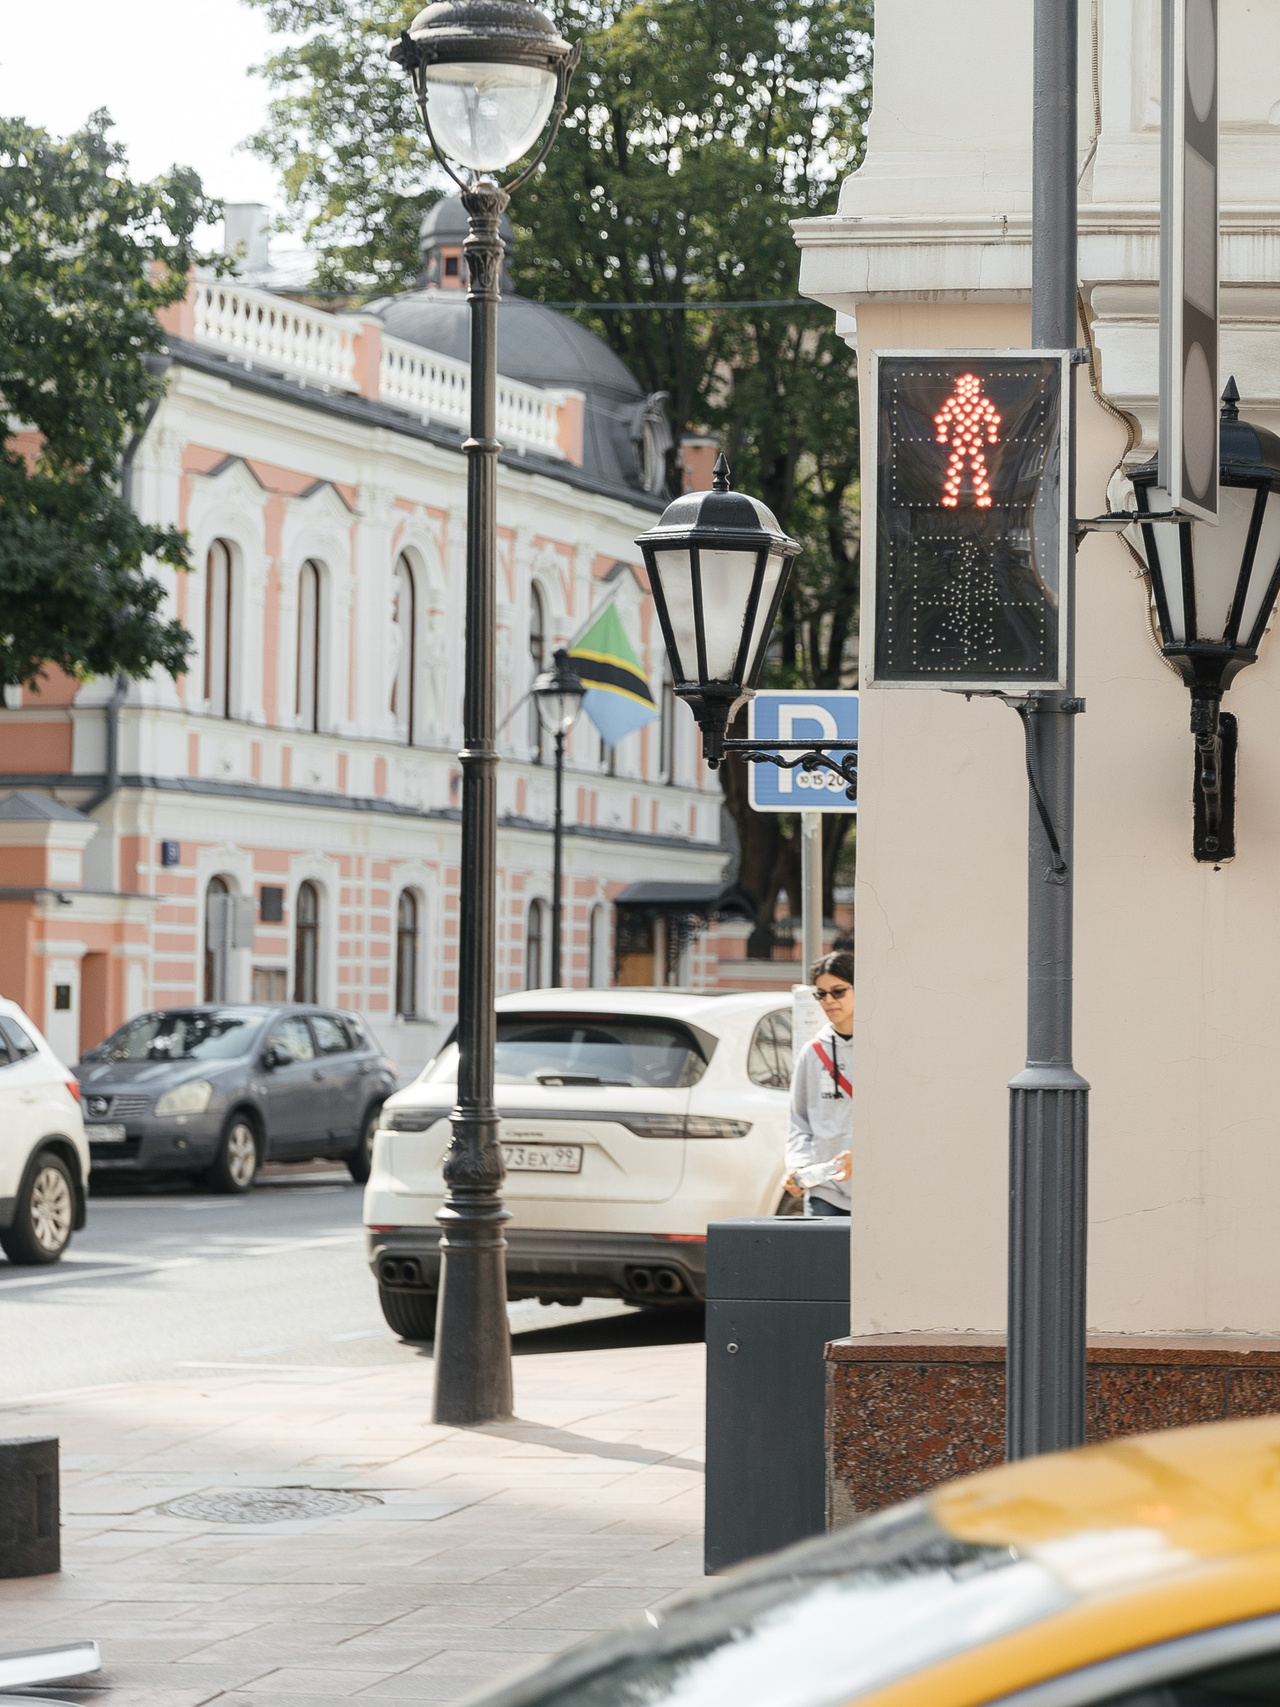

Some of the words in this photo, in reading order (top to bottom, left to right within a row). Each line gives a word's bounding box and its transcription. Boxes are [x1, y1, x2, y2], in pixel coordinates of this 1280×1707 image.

[778, 704, 838, 793] P
[813, 774, 823, 785] 15
[828, 773, 845, 786] 20
[504, 1147, 549, 1167] 73EX
